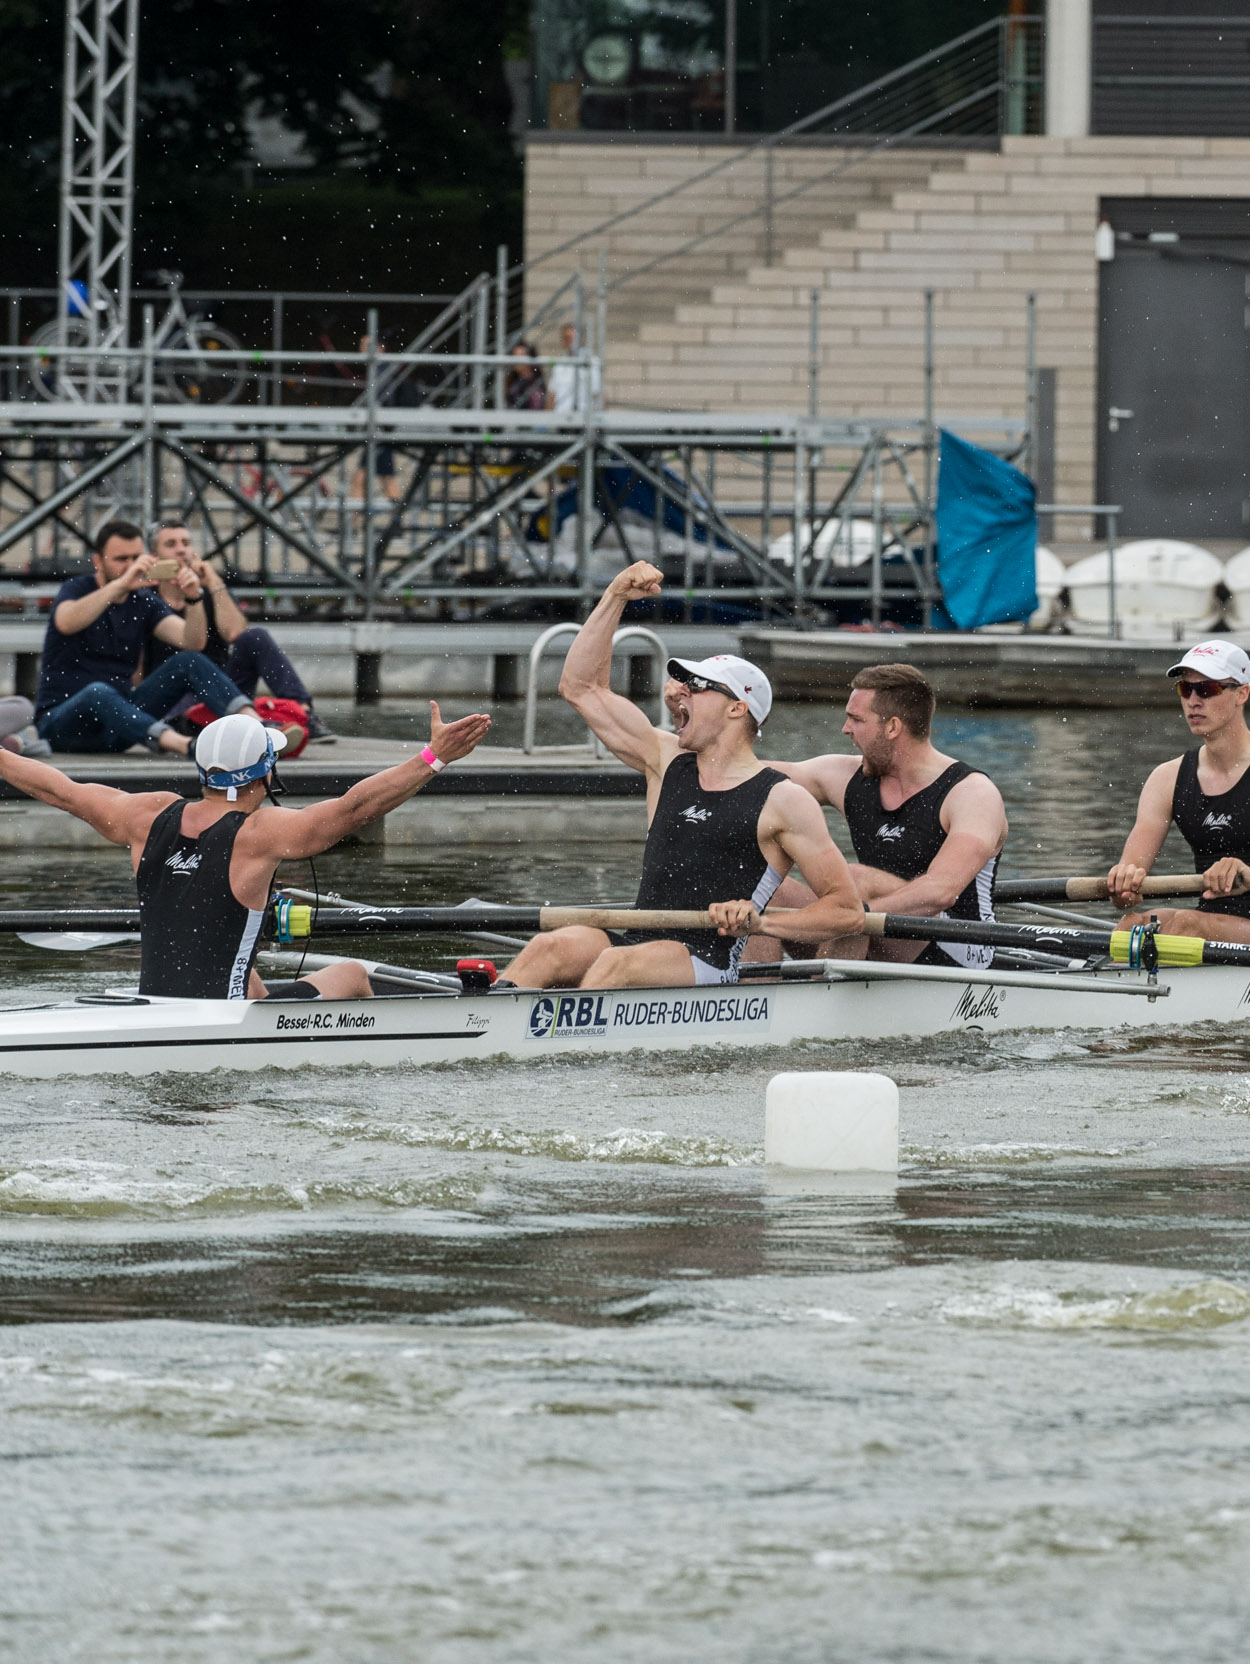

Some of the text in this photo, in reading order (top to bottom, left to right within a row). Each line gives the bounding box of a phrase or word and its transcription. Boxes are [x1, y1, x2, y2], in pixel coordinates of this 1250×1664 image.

[231, 769, 253, 783] NK
[466, 1013, 492, 1028] Filippi
[556, 997, 608, 1027] RBL
[613, 998, 768, 1026] RUDER-BUNDESLIGA
[276, 1013, 375, 1030] Bessel-R.C. Minden
